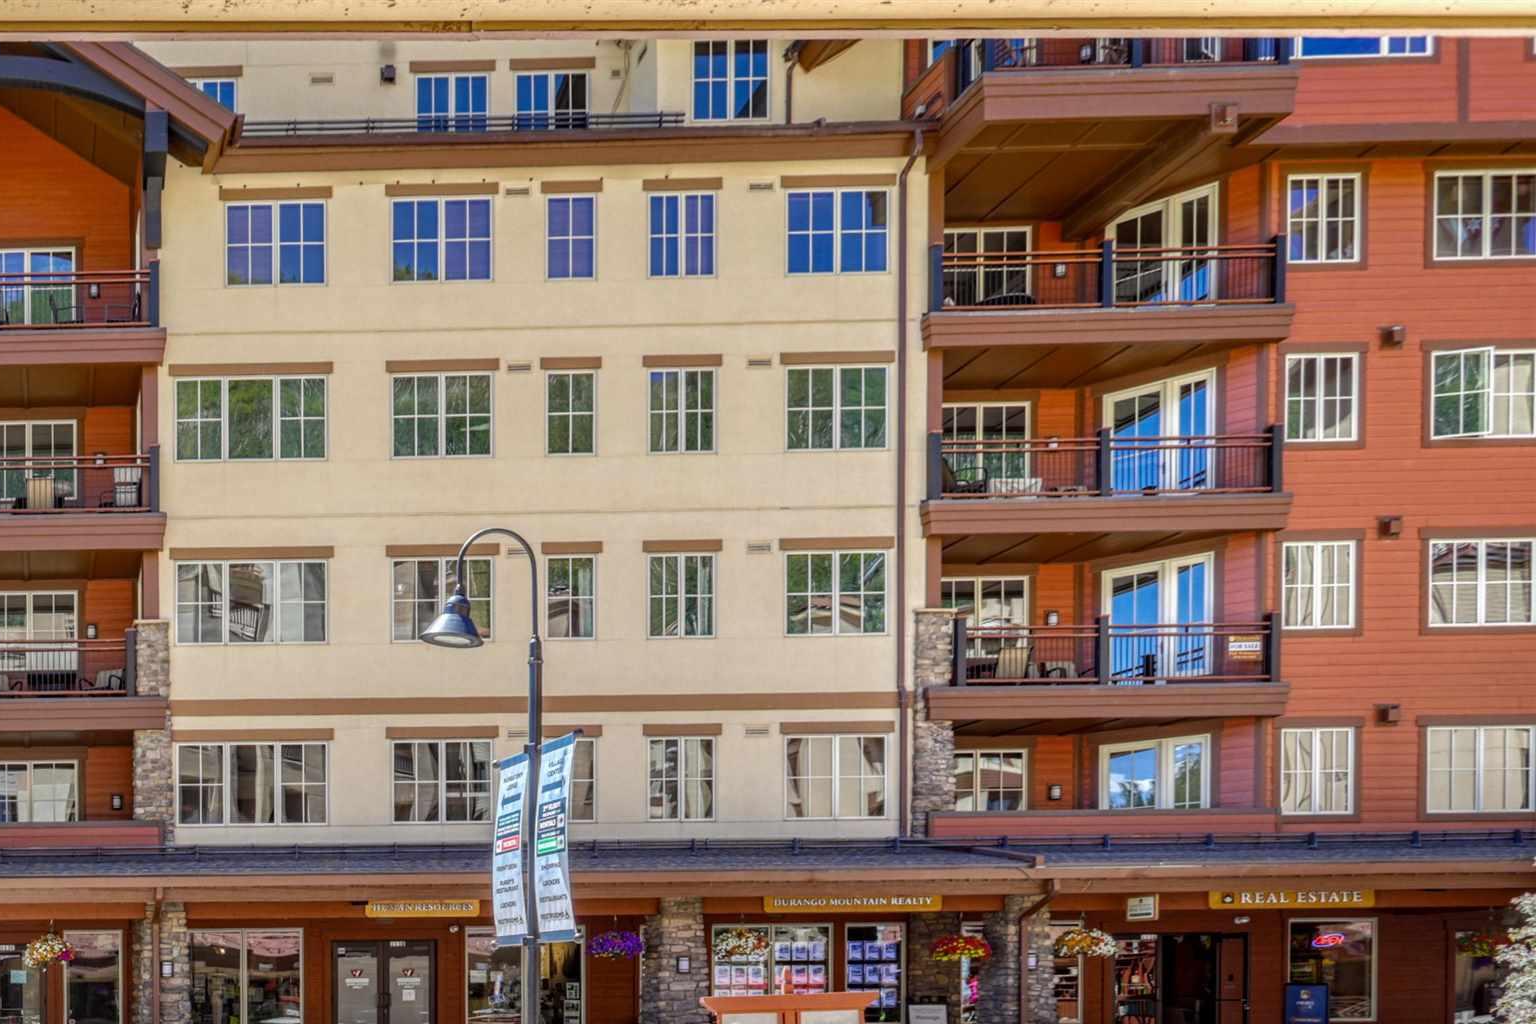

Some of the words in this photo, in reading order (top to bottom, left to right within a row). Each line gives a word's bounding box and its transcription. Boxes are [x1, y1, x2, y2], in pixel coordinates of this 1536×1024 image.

[774, 897, 826, 906] DURANGO
[830, 897, 888, 905] MOUNTAIN
[891, 896, 933, 905] REALTY
[1240, 892, 1289, 904] REAL
[1297, 891, 1363, 903] ESTATE
[373, 903, 414, 911] HUMAN
[415, 903, 473, 911] RESOURCES
